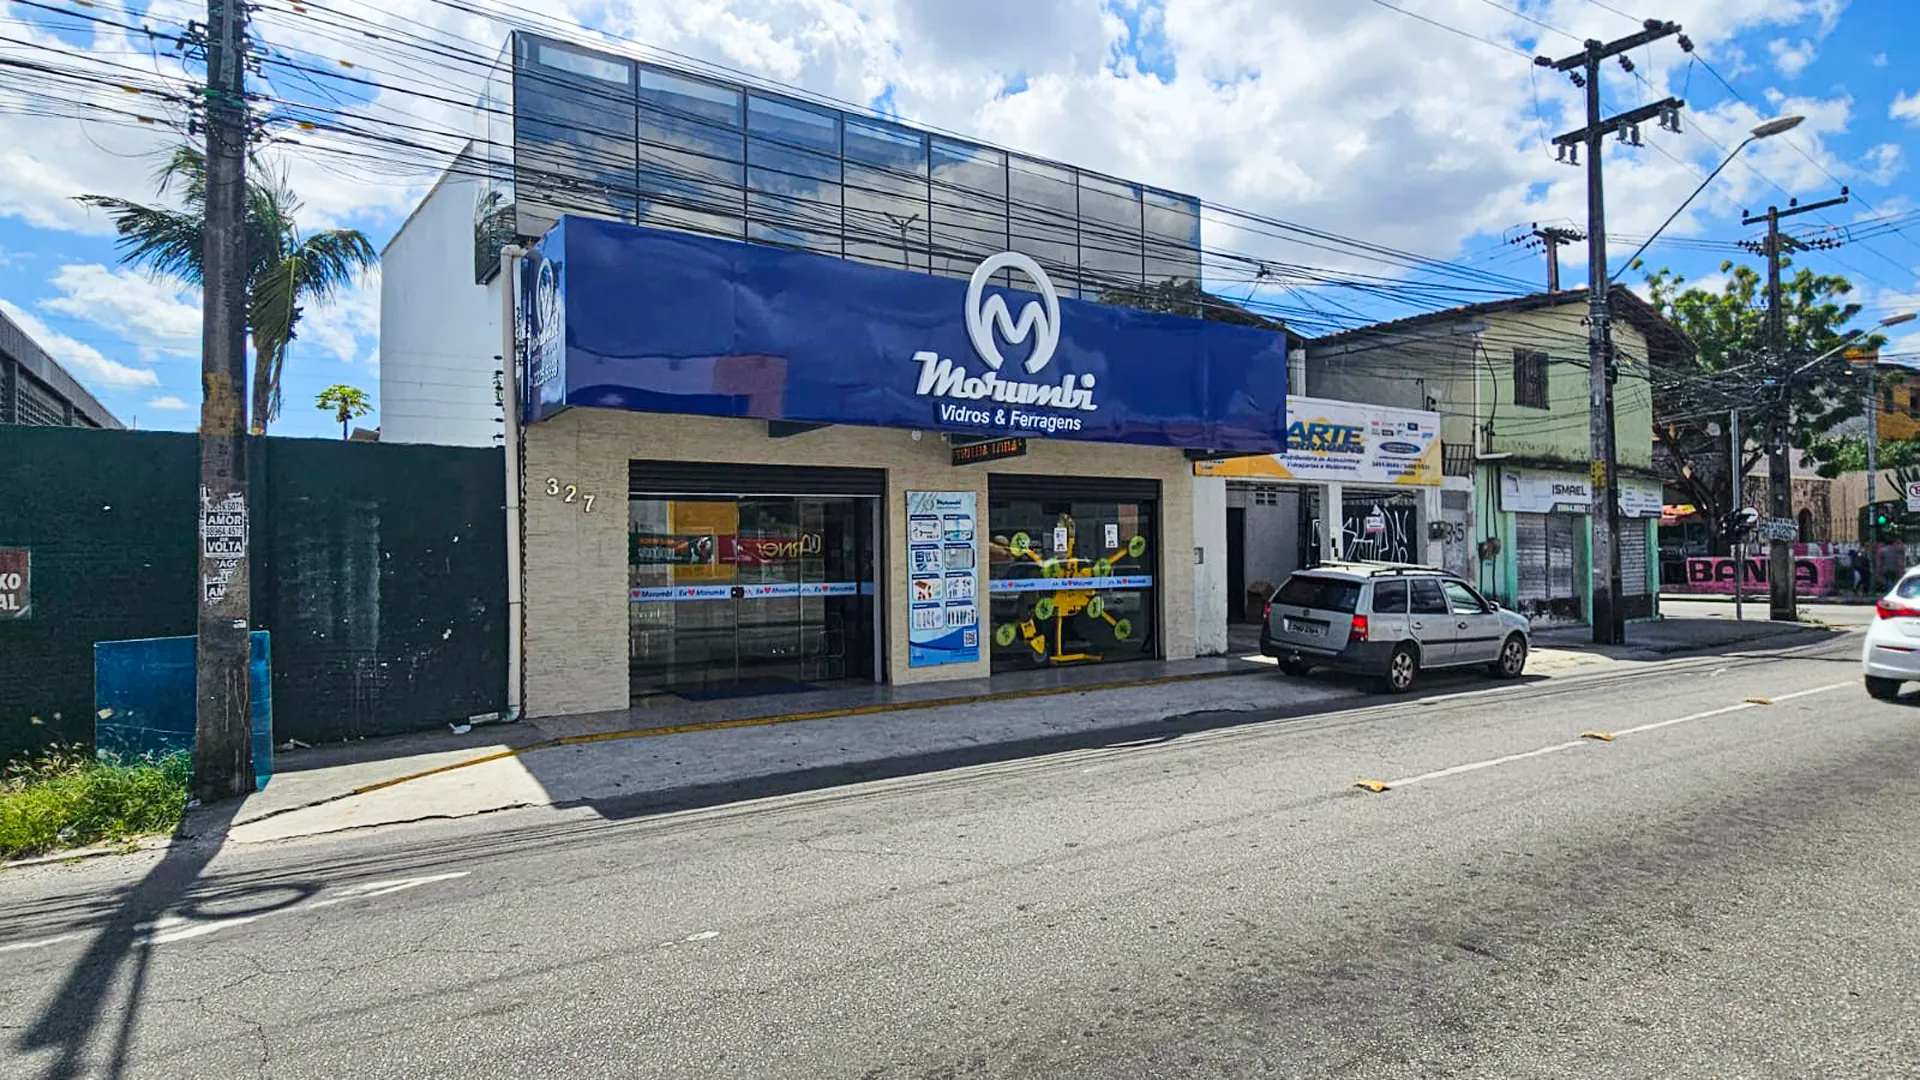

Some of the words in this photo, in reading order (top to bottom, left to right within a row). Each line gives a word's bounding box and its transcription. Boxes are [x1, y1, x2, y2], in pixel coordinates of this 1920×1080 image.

[912, 350, 1098, 412] Morumbi
[941, 404, 990, 425] Vidros
[994, 409, 1006, 425] &
[1010, 410, 1082, 432] Ferragens
[546, 477, 596, 513] 327
[1552, 484, 1587, 497] ISMAEL
[207, 515, 242, 525] AMOR
[207, 541, 242, 552] VOLTA
[1688, 559, 1818, 585] BANA
[696, 588, 725, 597] Morumbi
